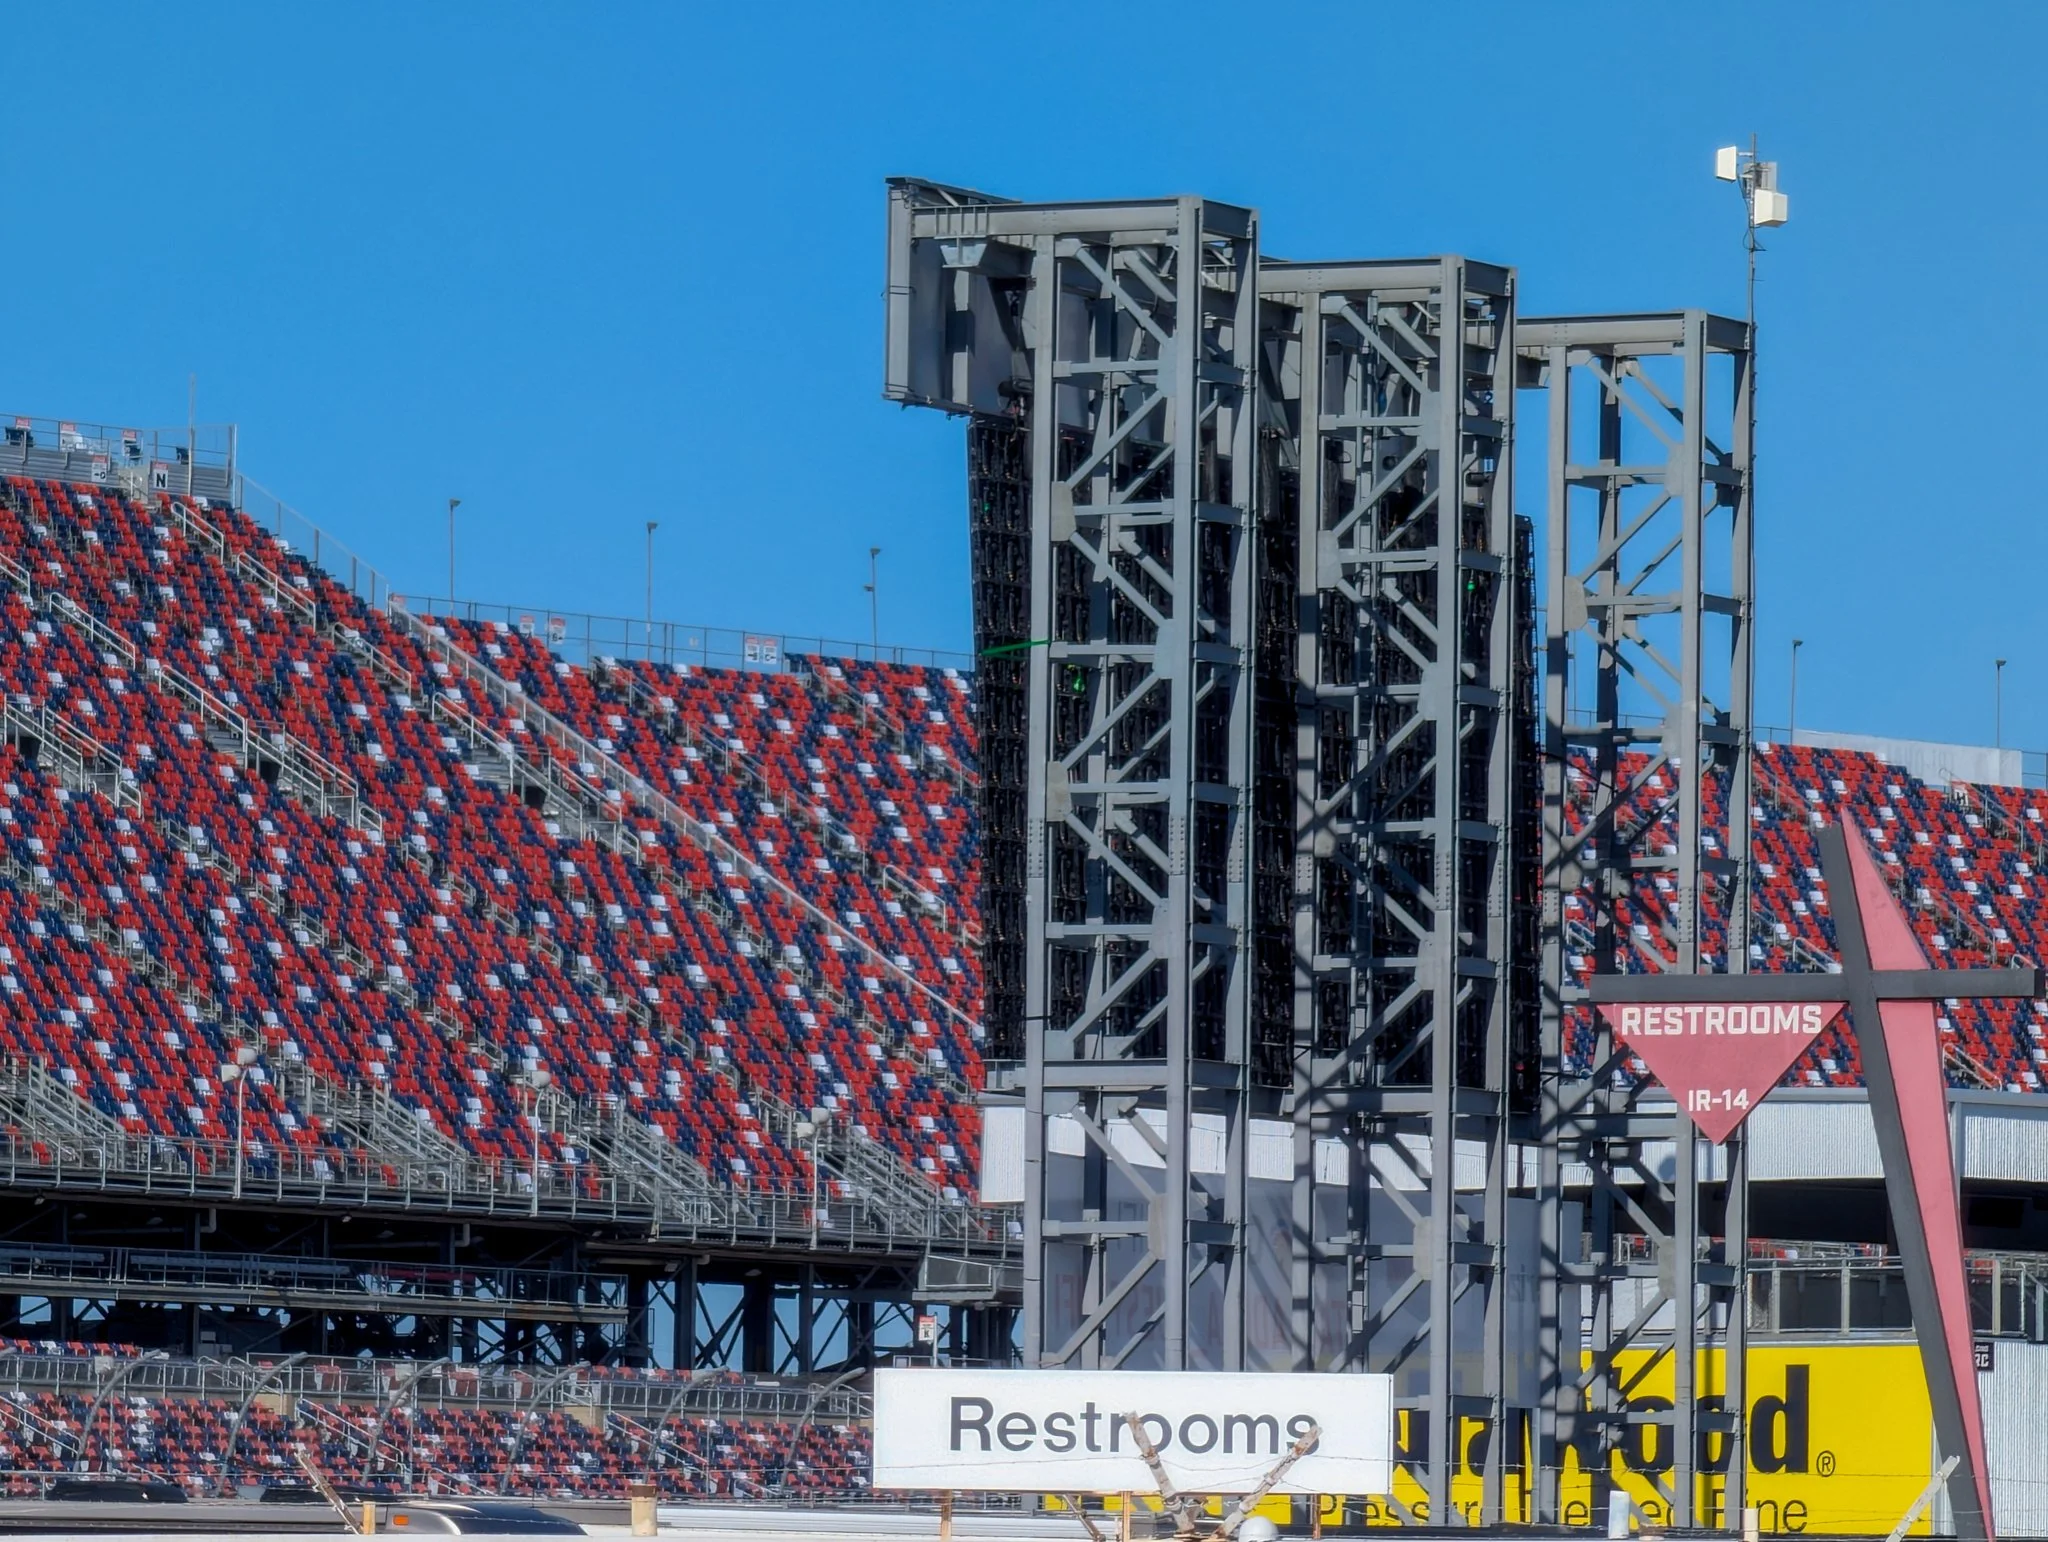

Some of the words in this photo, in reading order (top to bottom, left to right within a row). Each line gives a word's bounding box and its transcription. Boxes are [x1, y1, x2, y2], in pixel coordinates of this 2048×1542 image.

[156, 472, 166, 488] N
[1621, 1005, 1822, 1036] RESTROOMS
[1688, 1088, 1749, 1112] IR-14
[950, 1396, 1321, 1455] Restrooms
